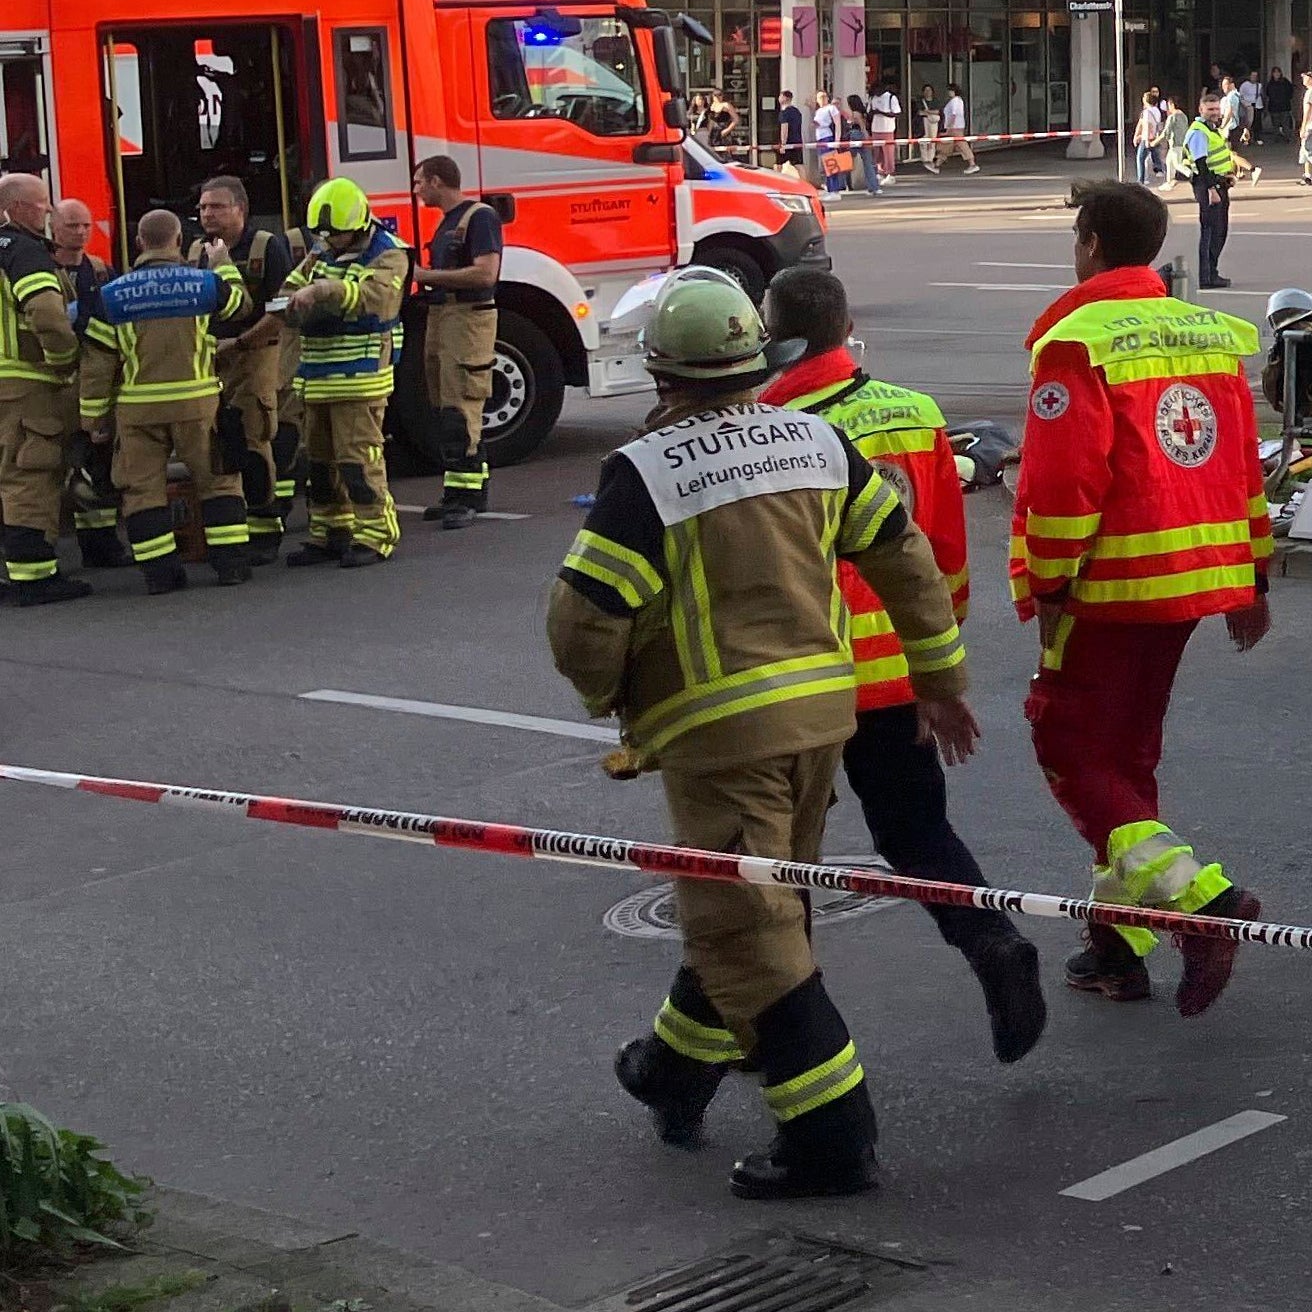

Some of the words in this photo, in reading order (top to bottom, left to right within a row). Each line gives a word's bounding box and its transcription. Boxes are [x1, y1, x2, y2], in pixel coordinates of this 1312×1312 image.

[114, 281, 203, 301] STUTTGART
[662, 421, 816, 470] STUTTGART
[675, 455, 815, 488] Leitungsdienst
[815, 452, 828, 469] 5
